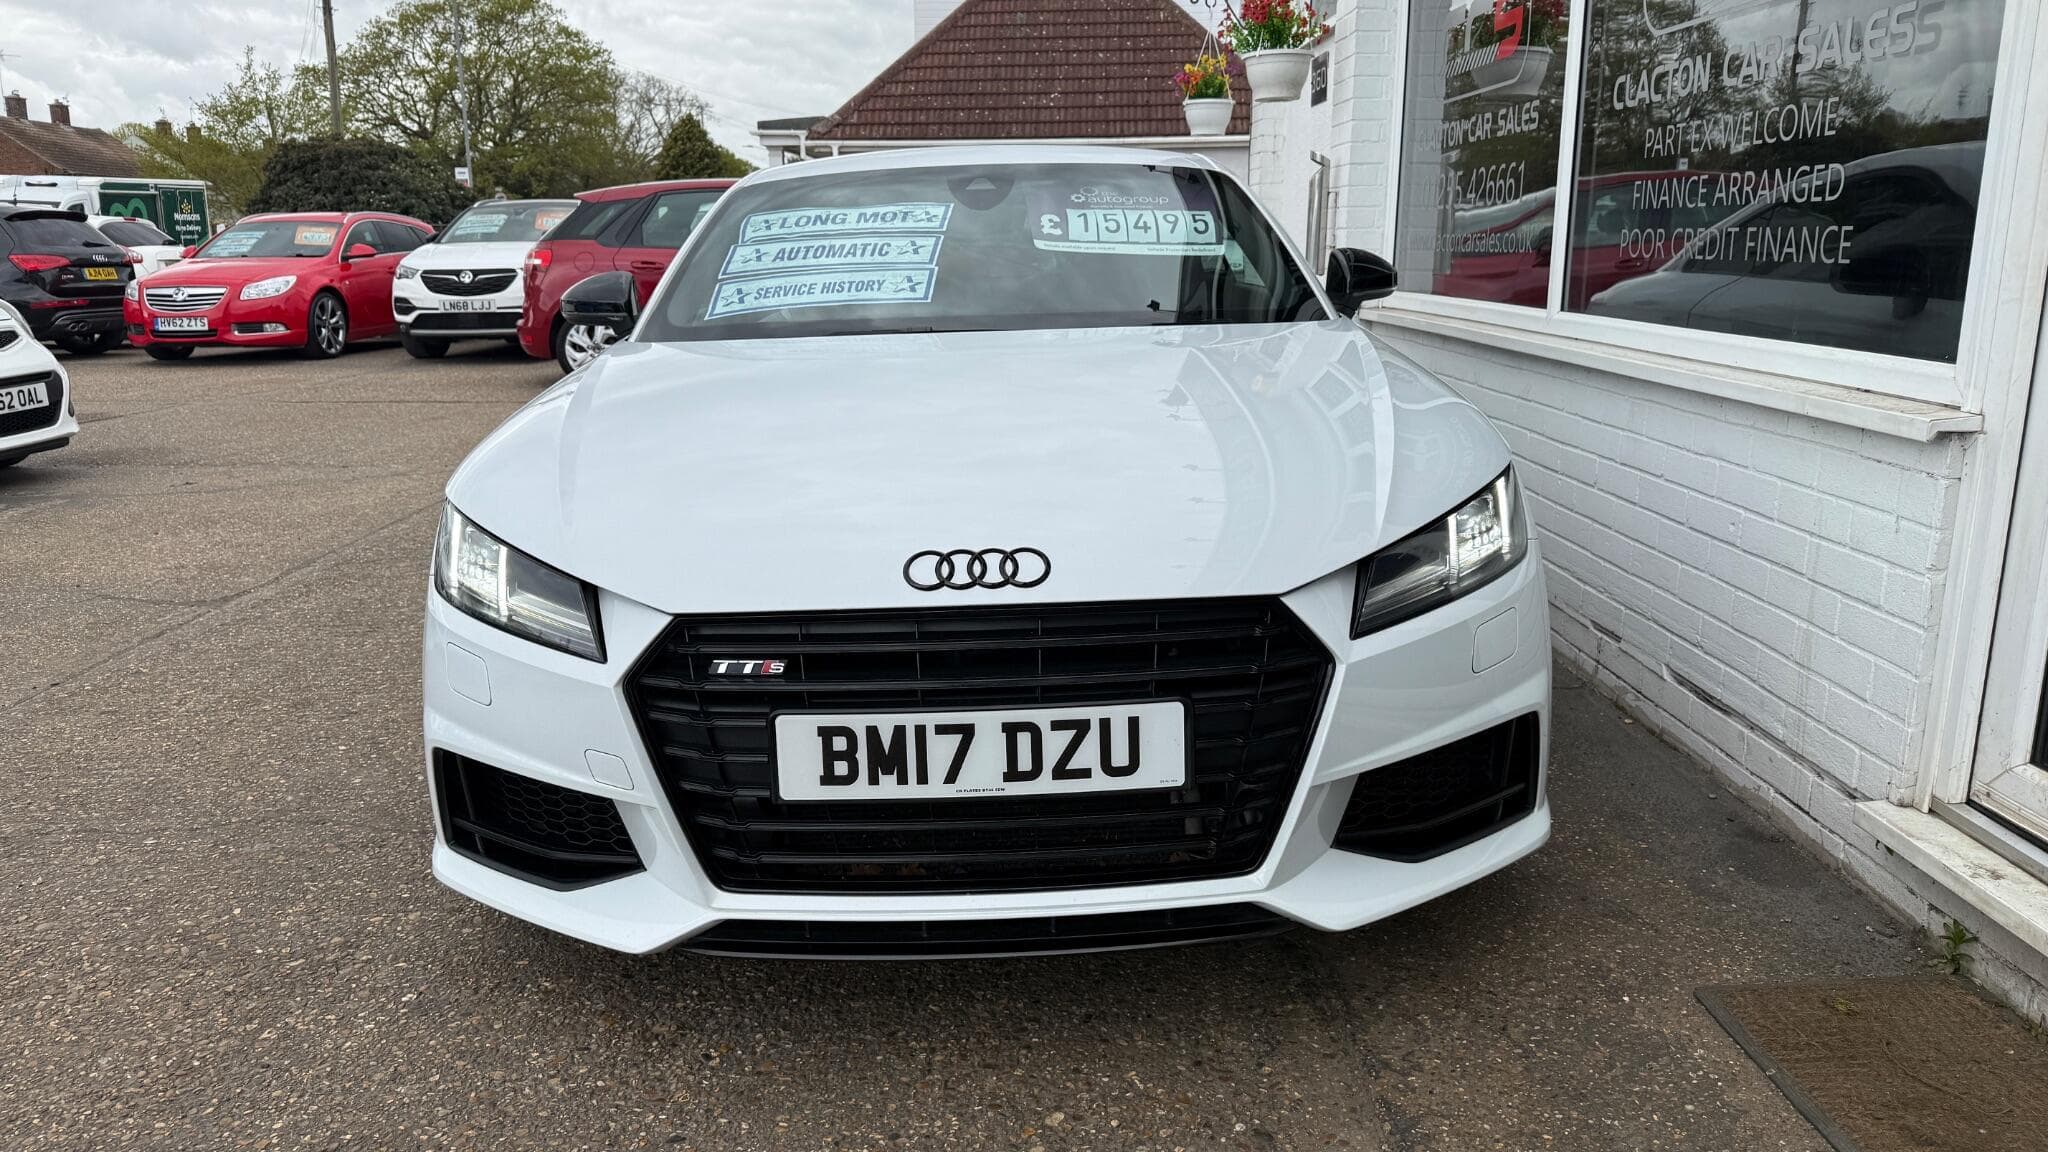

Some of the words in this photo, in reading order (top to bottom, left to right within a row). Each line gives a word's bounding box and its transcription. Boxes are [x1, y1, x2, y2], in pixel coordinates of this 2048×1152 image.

[1613, 52, 1712, 110] CLACTON
[1723, 35, 1783, 87] CAR
[1795, 0, 1919, 73] SALES
[1468, 111, 1492, 143] CAR
[1497, 100, 1540, 137] SALES
[1644, 122, 1688, 158] PART
[1691, 118, 1713, 153] EX
[1721, 97, 1840, 149] WELCOME
[1467, 160, 1526, 207] 426661
[1632, 174, 1709, 210] FINANCE
[1712, 163, 1846, 207] ARRANGED
[1087, 195, 1169, 205] autogroup
[779, 212, 849, 230] LONG
[855, 210, 911, 225] MOT
[771, 242, 892, 263] AUTOMATIC
[1619, 228, 1666, 258] POOR
[1671, 226, 1740, 261] CREDIT
[1744, 225, 1854, 264] FINANCE
[753, 283, 817, 301] SERVICE
[820, 279, 886, 295] HISTORY
[442, 301, 469, 311] LN68
[471, 301, 492, 311] LJJ
[160, 318, 184, 328] HV62
[187, 317, 207, 328] ZTS
[17, 387, 43, 407] OAL
[712, 659, 785, 675] TTS
[817, 722, 976, 787] BM17
[1001, 715, 1140, 783] DZU
